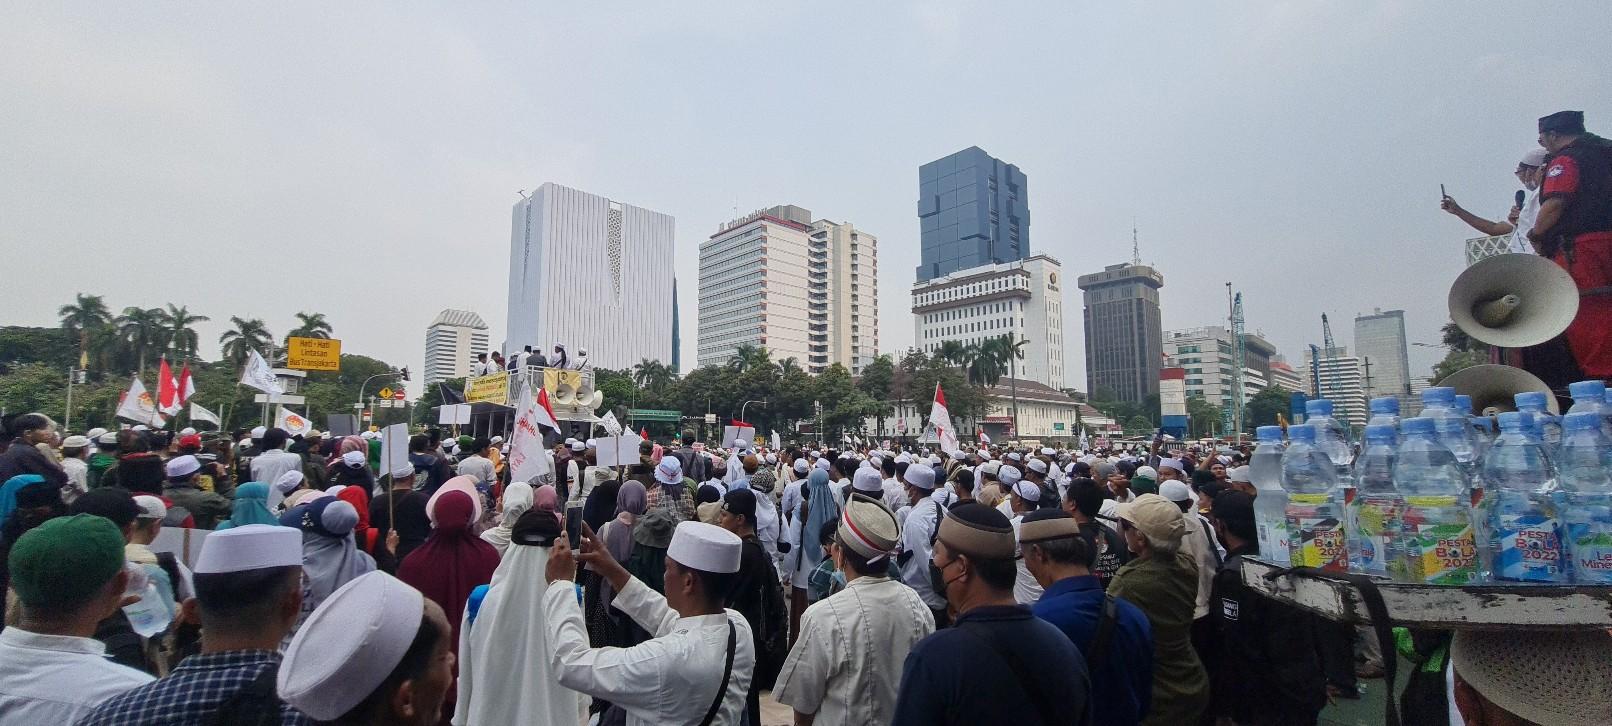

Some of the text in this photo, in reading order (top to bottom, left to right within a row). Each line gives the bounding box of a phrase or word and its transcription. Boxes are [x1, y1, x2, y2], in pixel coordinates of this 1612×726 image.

[300, 339, 330, 349] Hati Hati
[301, 349, 328, 358] Lintasan
[1523, 550, 1558, 560] 2022
